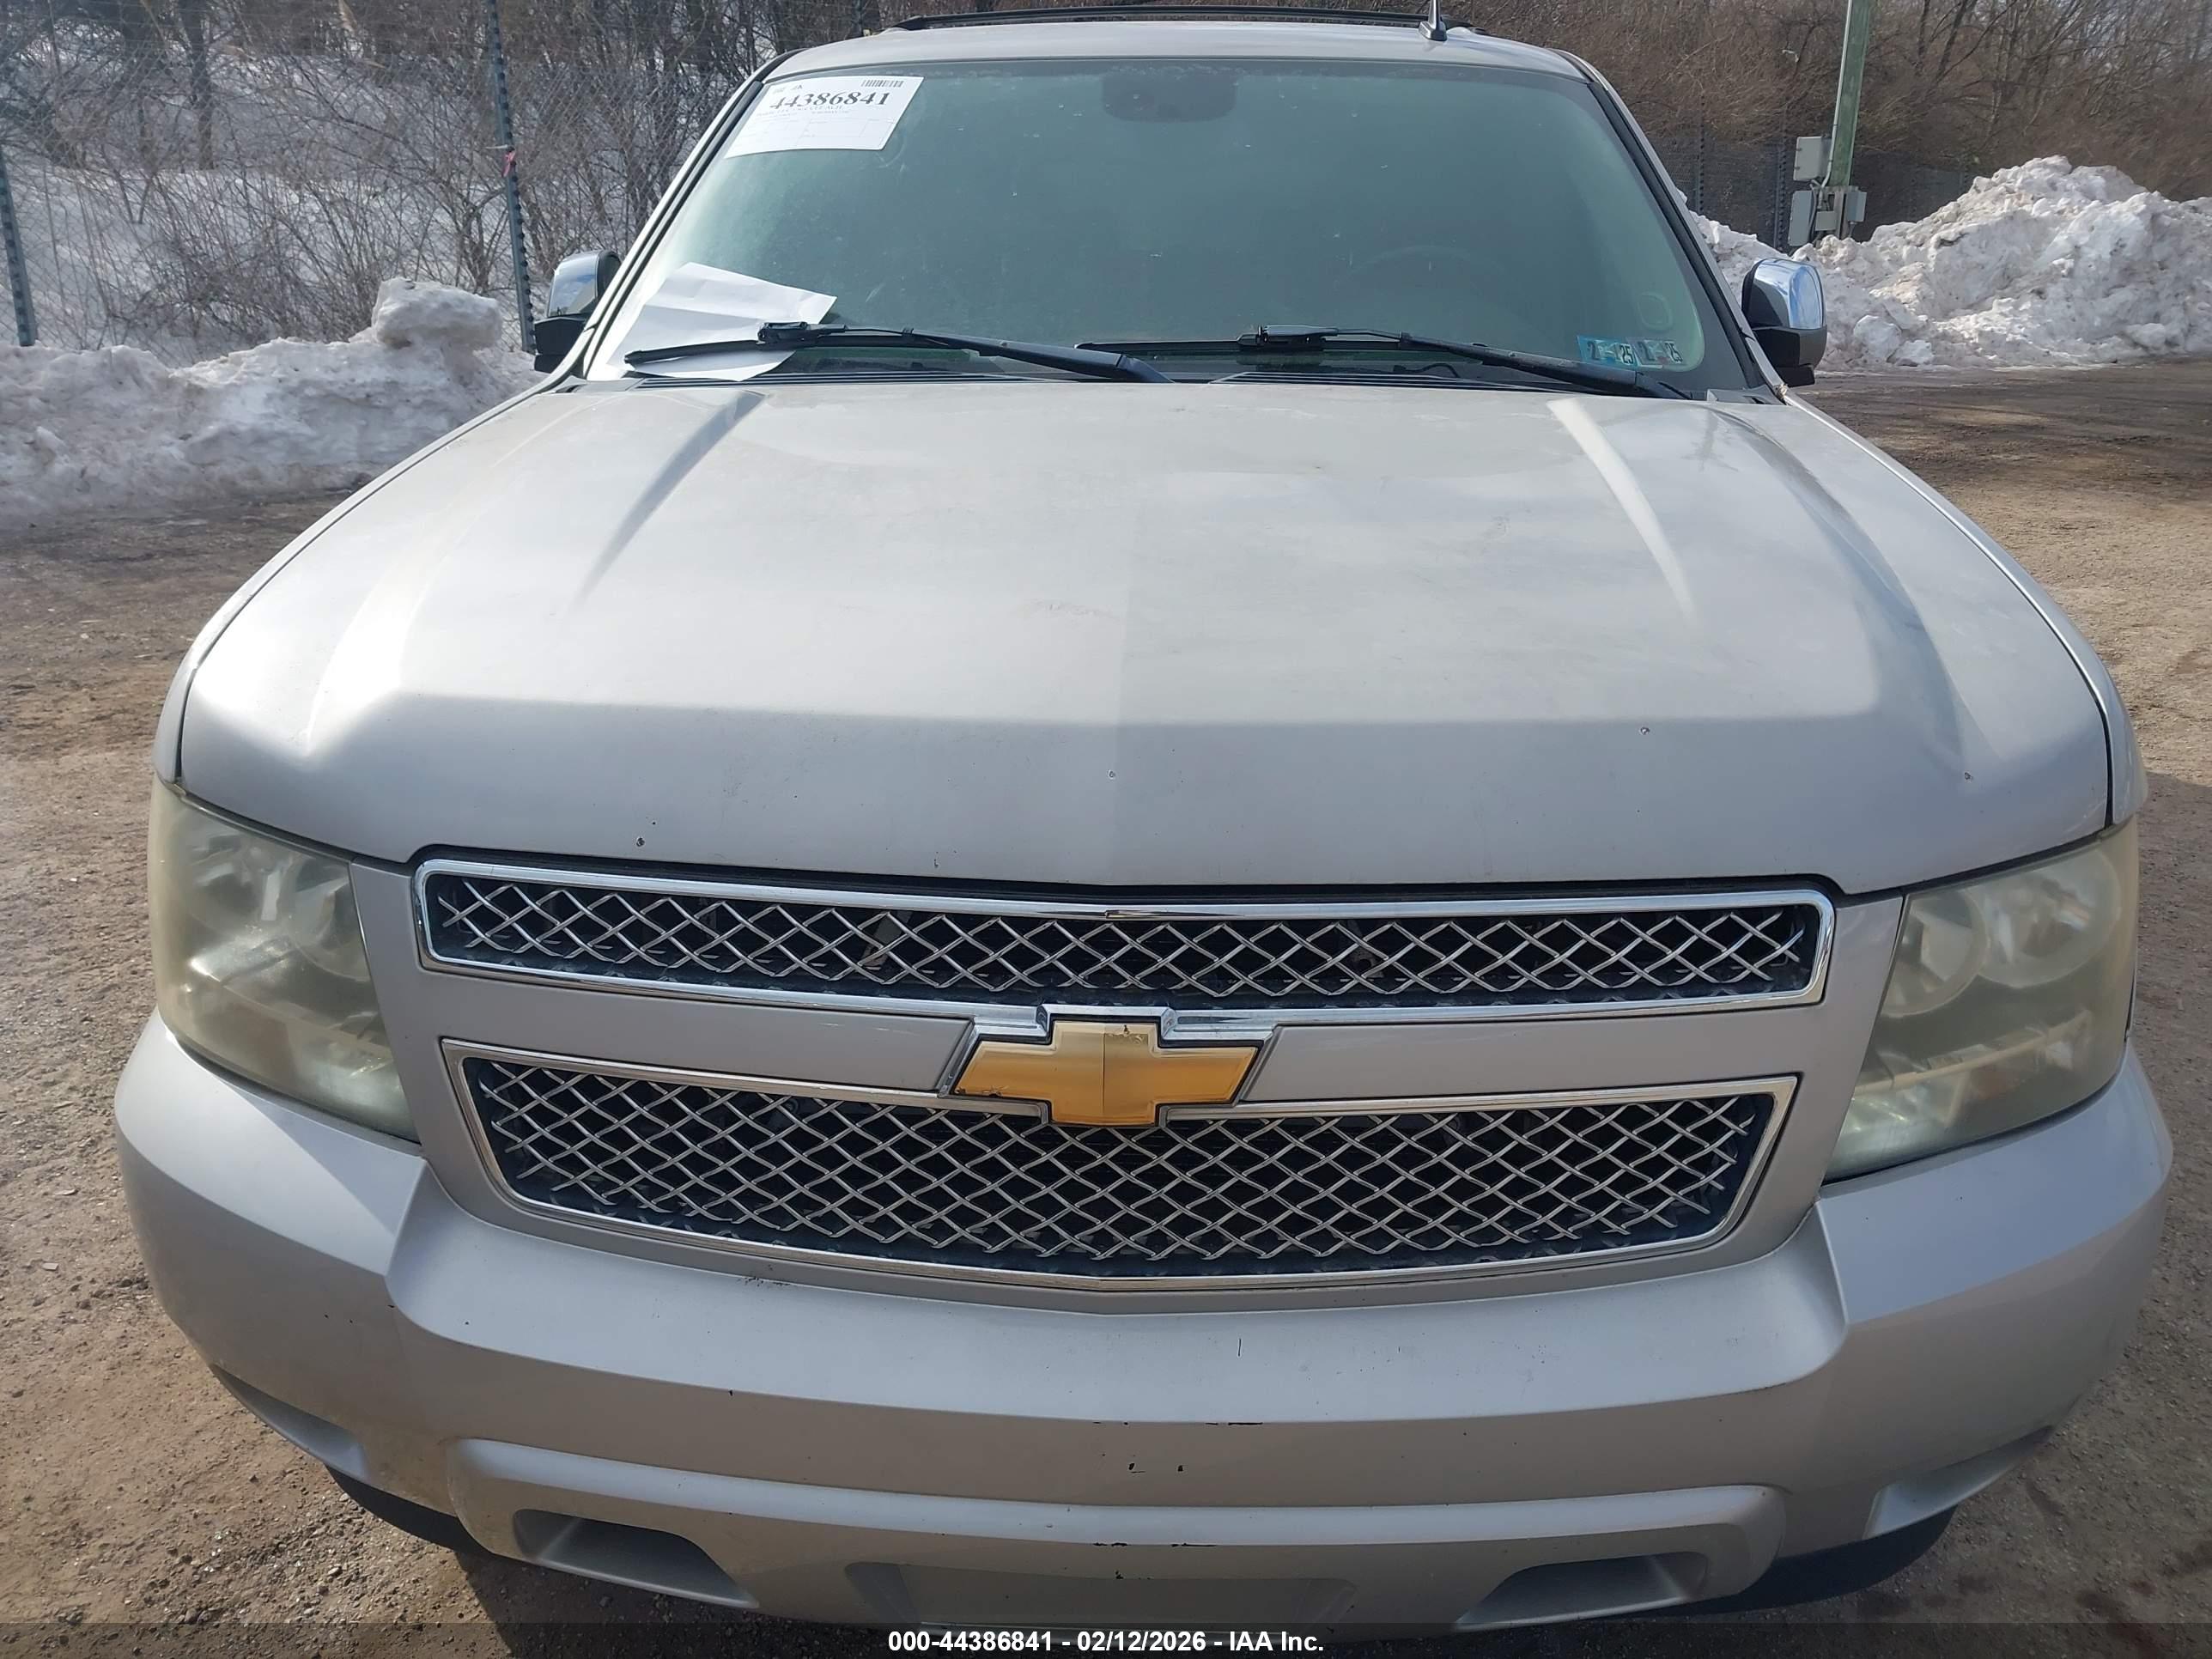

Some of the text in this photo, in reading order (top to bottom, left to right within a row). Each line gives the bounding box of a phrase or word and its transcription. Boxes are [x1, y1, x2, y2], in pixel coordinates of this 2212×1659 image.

[769, 91, 891, 110] 44386841
[1620, 343, 1634, 365] 25
[1664, 342, 1684, 363] 25
